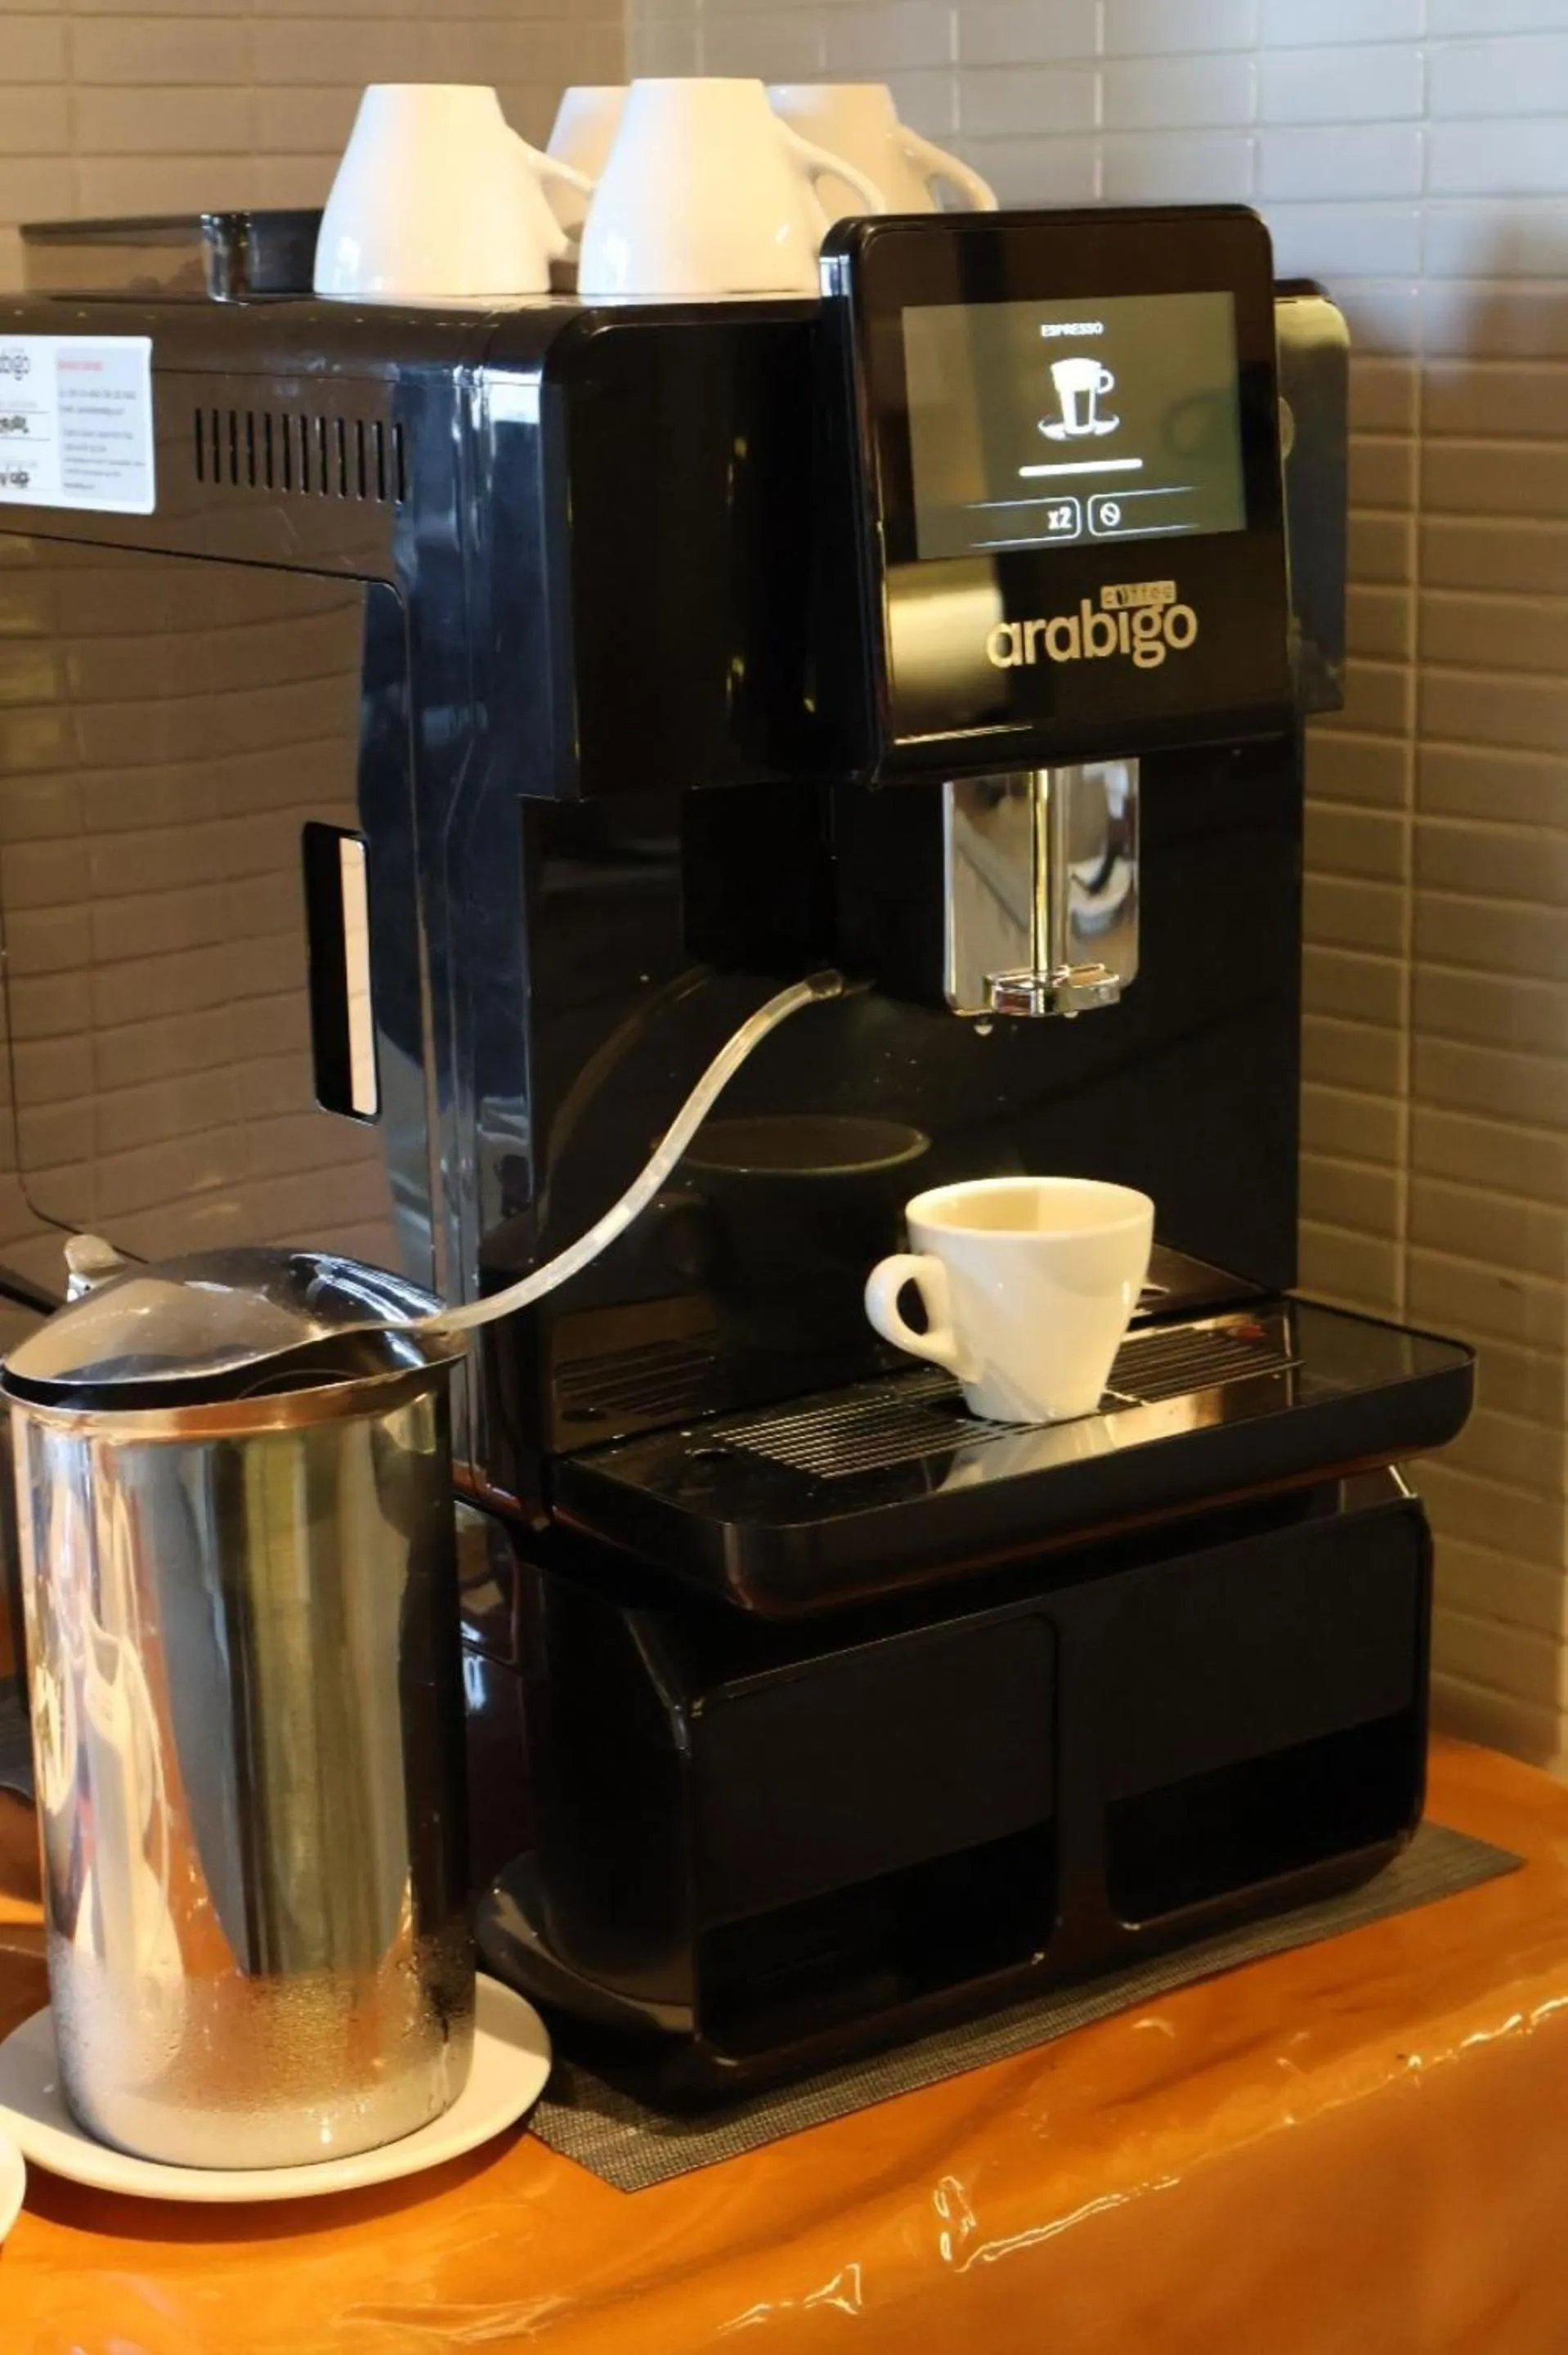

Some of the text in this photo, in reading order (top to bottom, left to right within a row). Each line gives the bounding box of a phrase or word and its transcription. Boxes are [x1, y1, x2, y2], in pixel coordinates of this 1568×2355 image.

[1042, 321, 1104, 337] ESPRESSO
[1047, 506, 1073, 530] x2
[987, 599, 1197, 668] arabigo
